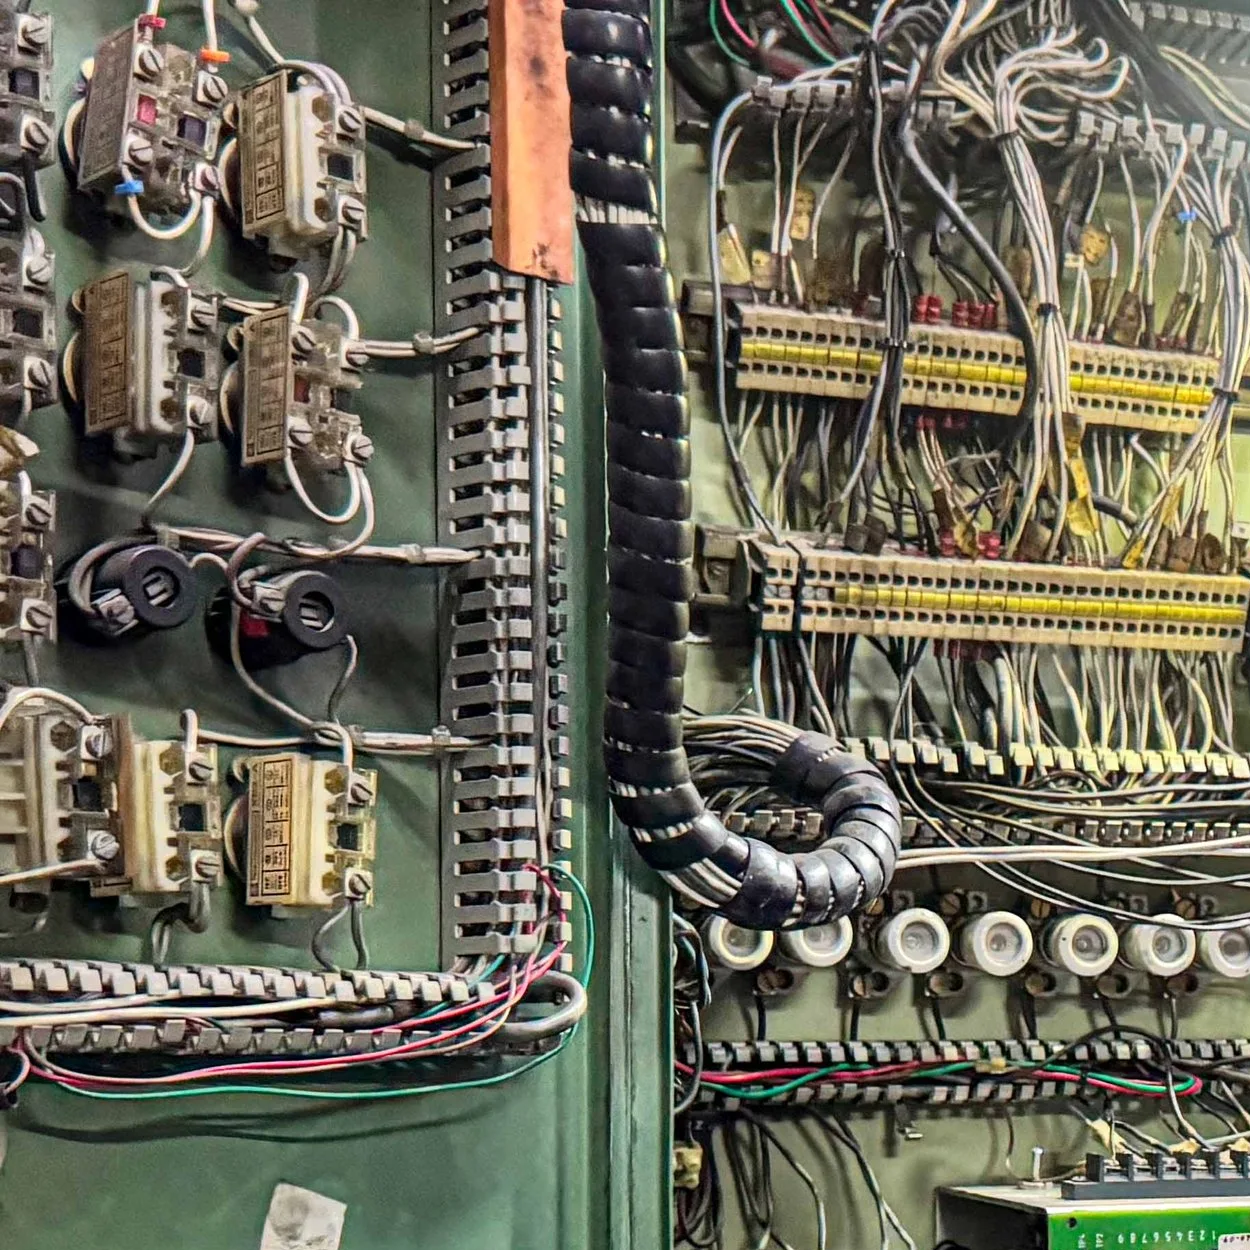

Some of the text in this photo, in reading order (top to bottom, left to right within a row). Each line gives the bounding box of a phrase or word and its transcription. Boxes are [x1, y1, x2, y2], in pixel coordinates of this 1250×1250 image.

[1118, 1230, 1216, 1244] 1 2 3 4 5 6 7 8 9
